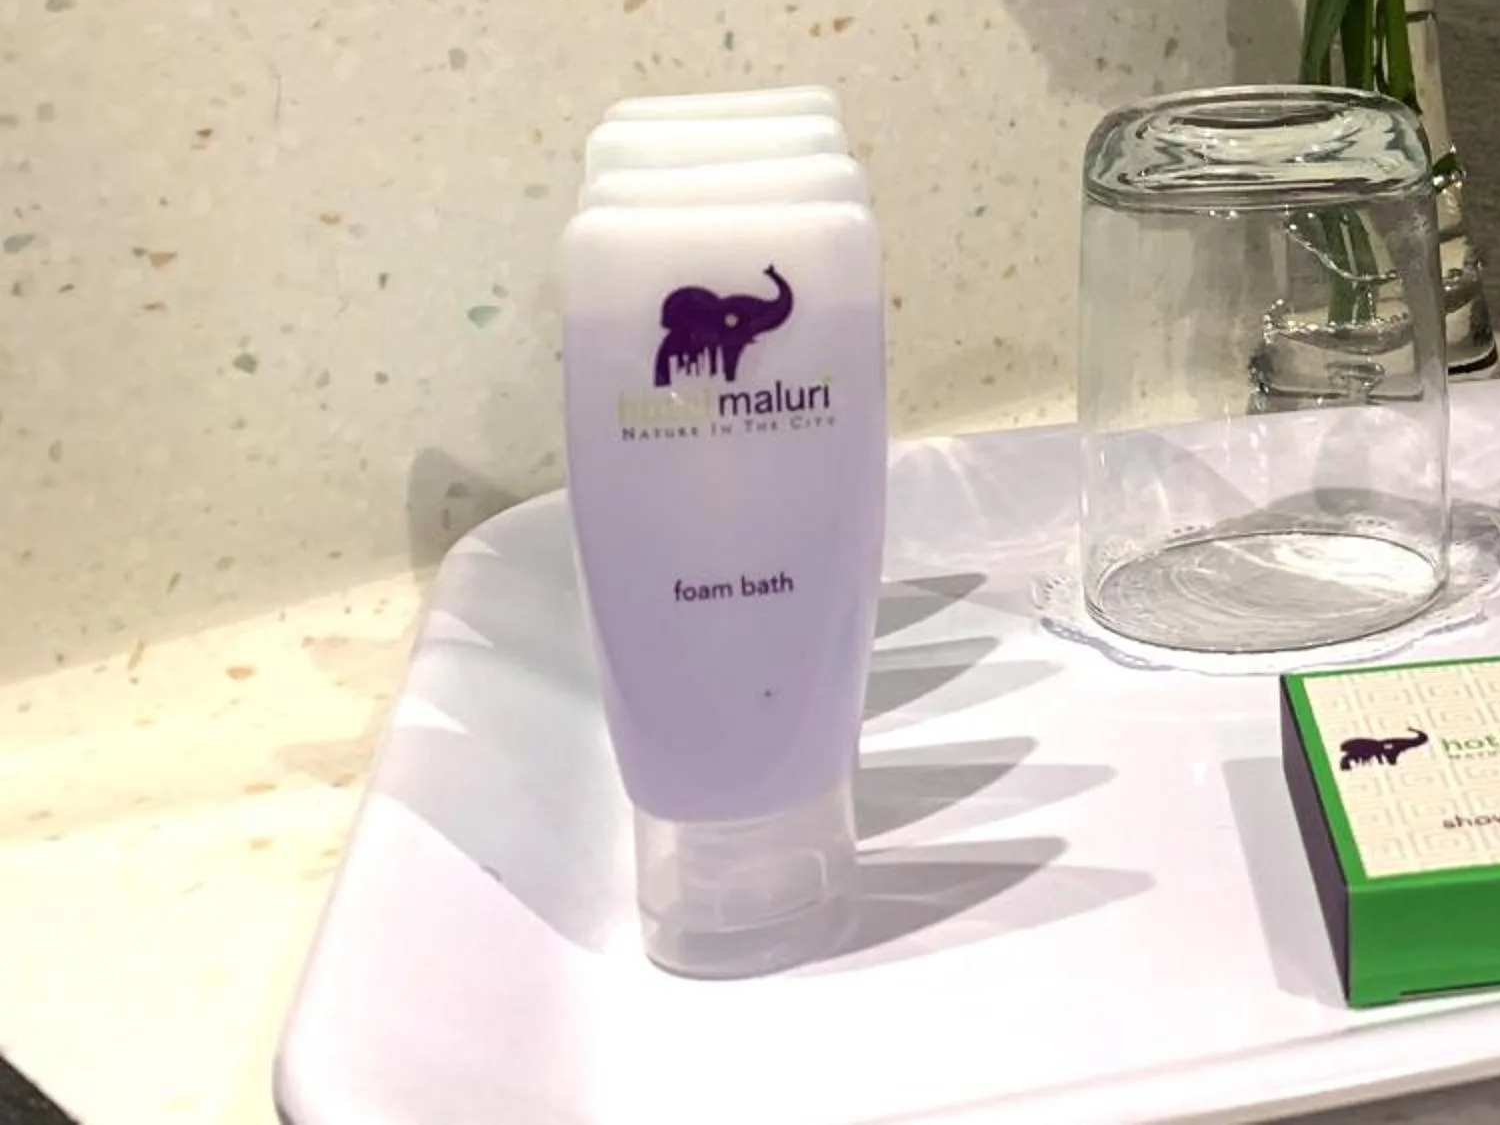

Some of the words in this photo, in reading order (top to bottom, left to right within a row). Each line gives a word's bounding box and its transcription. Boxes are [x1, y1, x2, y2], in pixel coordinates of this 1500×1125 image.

[718, 375, 833, 417] maluri
[673, 579, 733, 602] foam
[741, 572, 795, 597] bath
